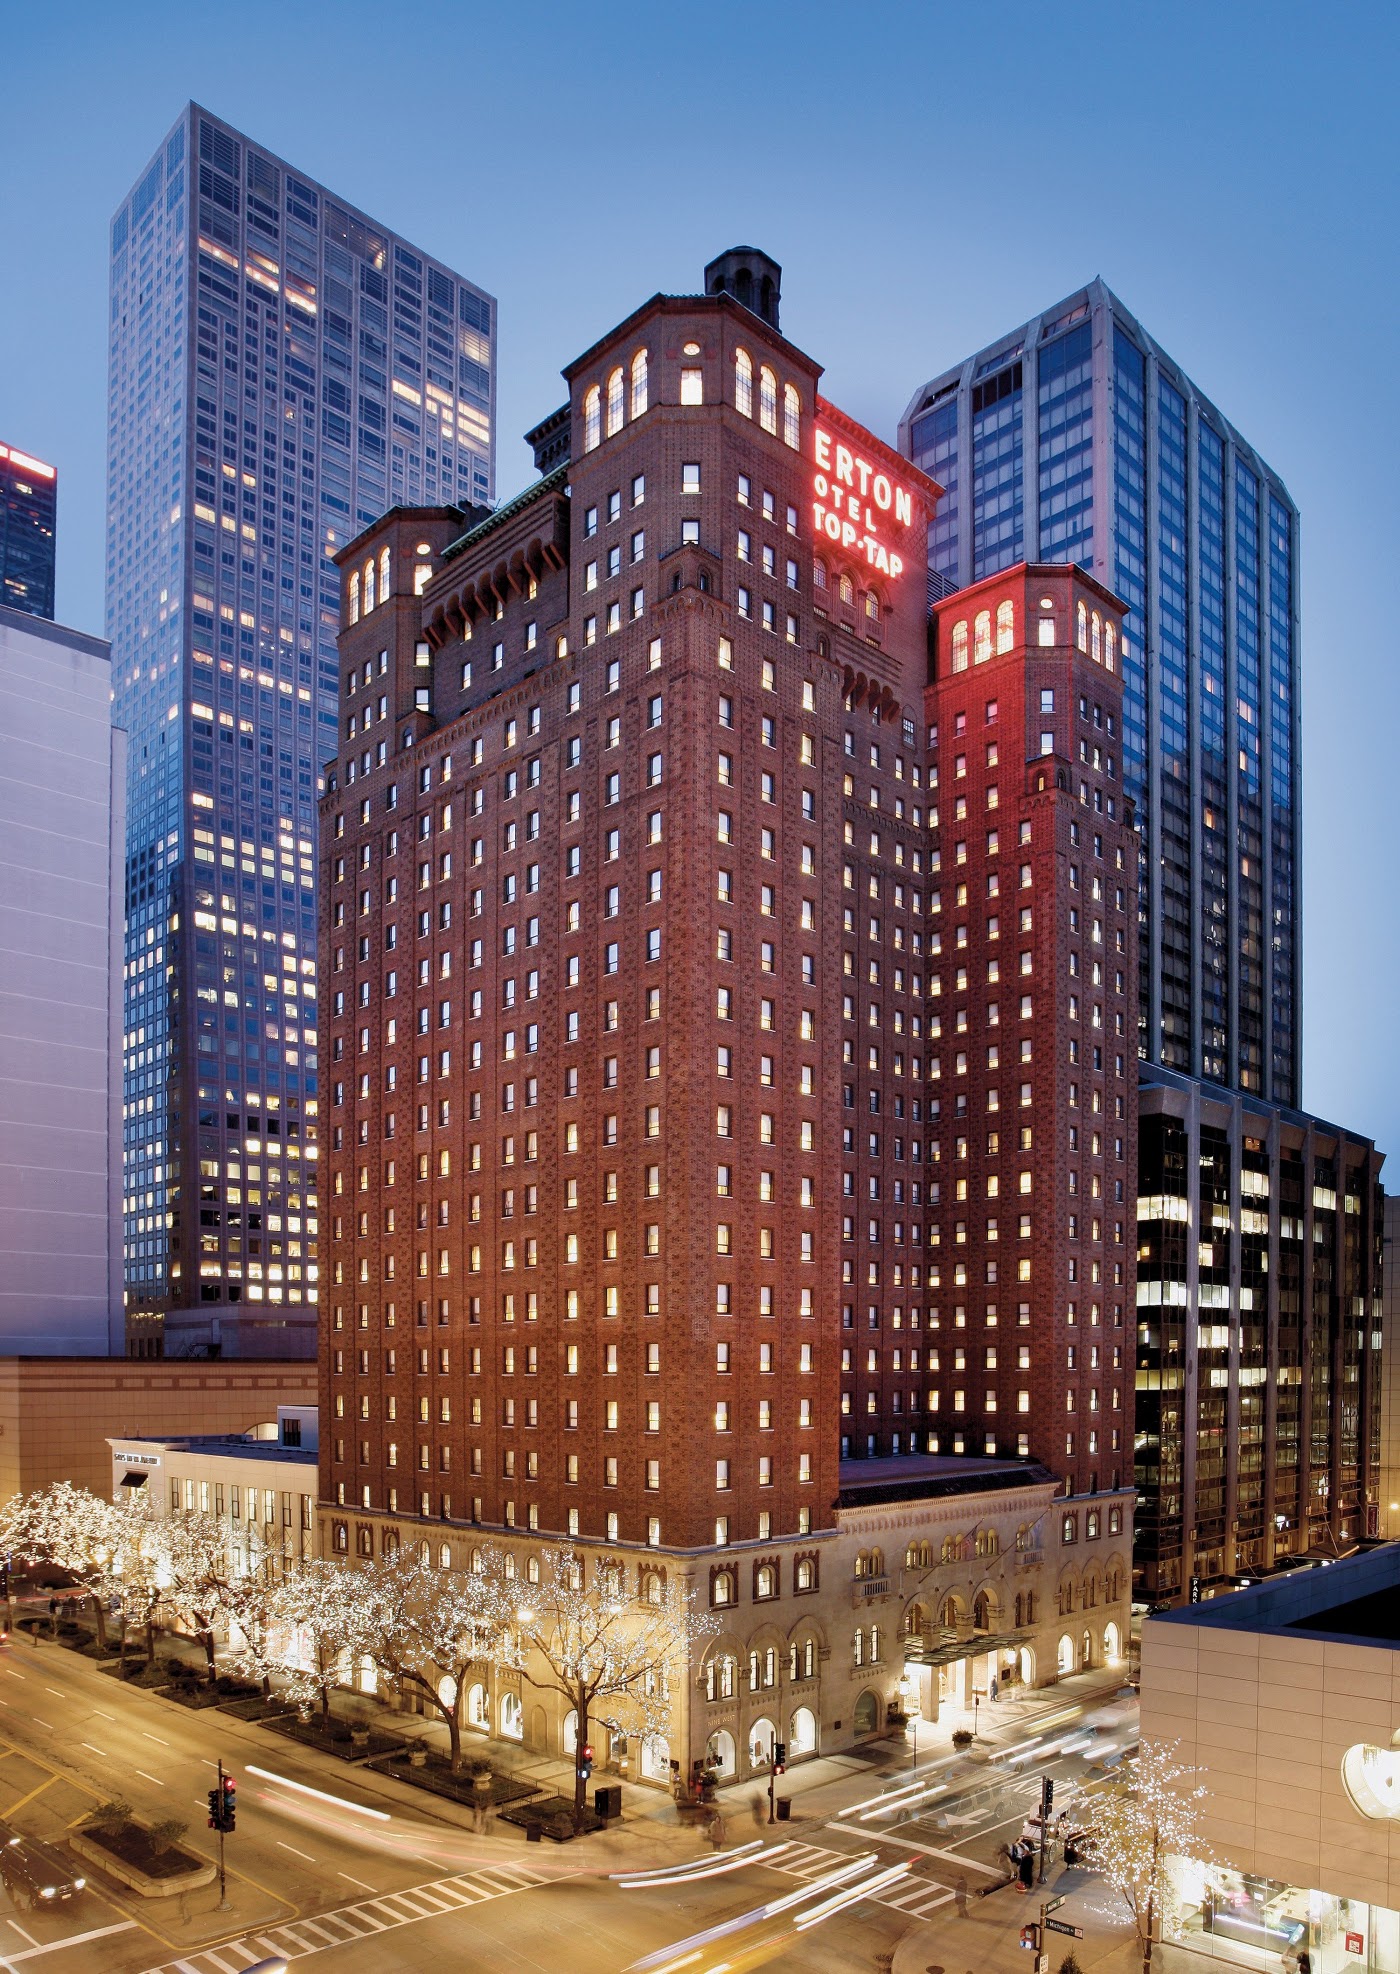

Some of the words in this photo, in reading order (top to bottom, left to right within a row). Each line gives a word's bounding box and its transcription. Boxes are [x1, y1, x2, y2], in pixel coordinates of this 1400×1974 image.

[814, 474, 876, 532] OTEL
[815, 428, 911, 527] ERTON
[1049, 1921, 1070, 1932] Michigan
